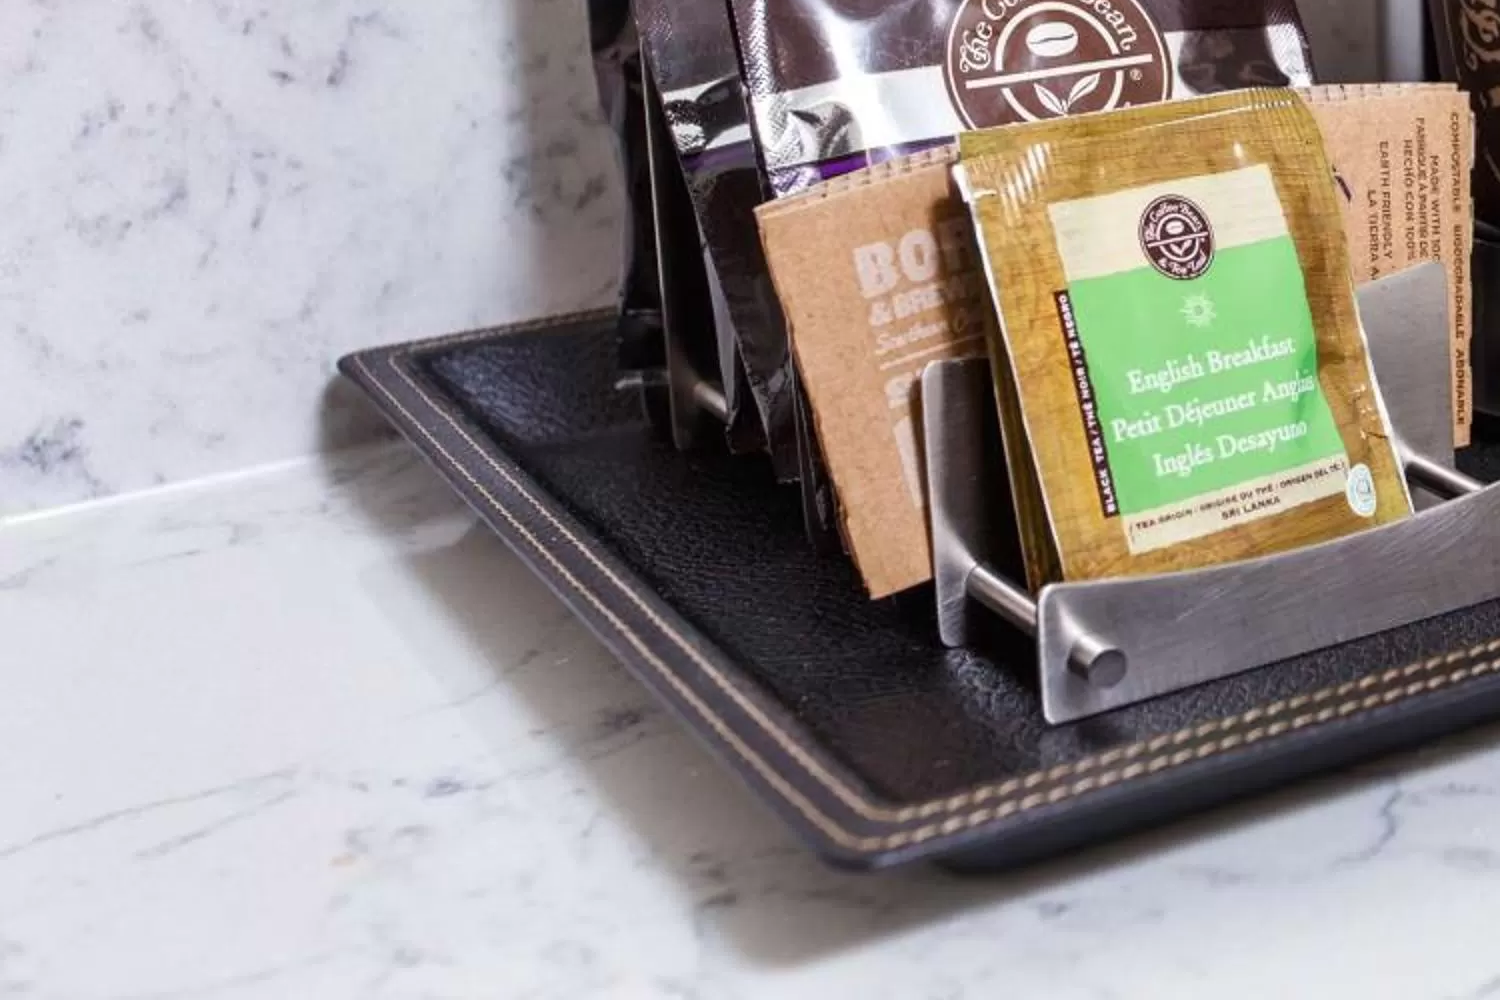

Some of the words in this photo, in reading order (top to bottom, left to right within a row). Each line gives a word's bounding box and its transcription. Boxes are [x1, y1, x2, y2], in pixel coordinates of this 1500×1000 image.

[960, 21, 993, 73] The
[1379, 140, 1391, 187] EARTH
[1403, 139, 1414, 189] HECHO
[1429, 154, 1440, 194] MADE
[1450, 111, 1462, 213] COMPOSTABLE
[1367, 188, 1378, 208] LA
[1405, 193, 1415, 222] CON
[1430, 199, 1441, 239] WITH
[1368, 215, 1380, 263] TIERRA
[1381, 191, 1393, 260] FRIENDLY
[1126, 353, 1205, 393] English
[1206, 335, 1297, 373] Breakfast
[1111, 410, 1163, 443] Petit
[1165, 389, 1257, 429] Déjeuner
[1091, 437, 1105, 463] TEA
[1153, 443, 1215, 477] Inglés
[1216, 420, 1308, 459] Desayuno
[1098, 468, 1116, 513] BLACK
